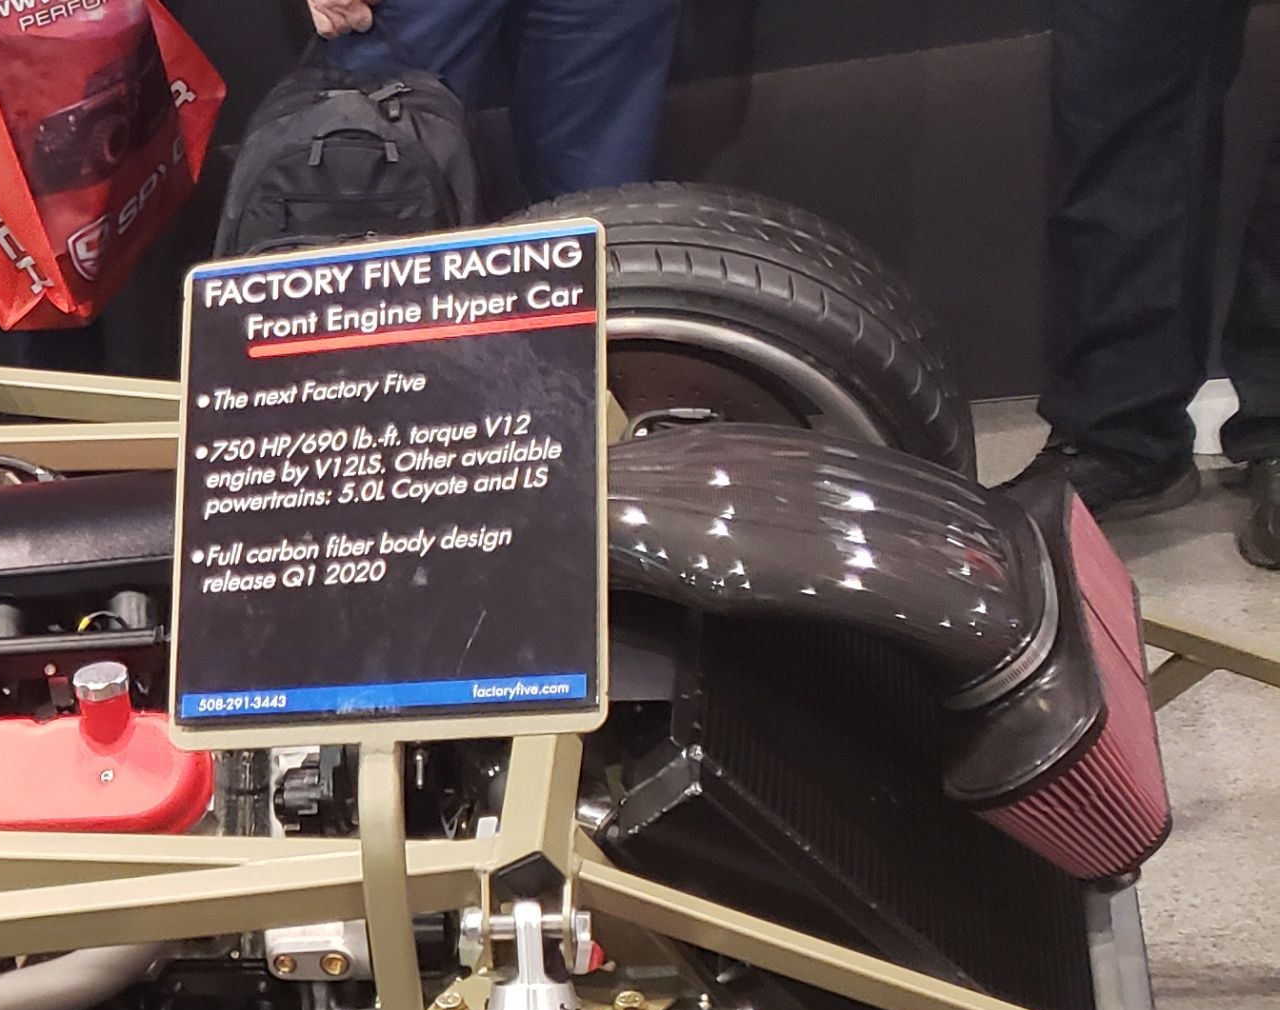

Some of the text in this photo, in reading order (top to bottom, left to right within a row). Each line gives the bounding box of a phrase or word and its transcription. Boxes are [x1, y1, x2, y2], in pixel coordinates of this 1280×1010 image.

[19, 0, 108, 32] PERFO
[205, 240, 583, 308] FACTORY FIVE RACING
[247, 281, 583, 340] Front Engine Hyper Car
[213, 373, 427, 411] The next Factory Five
[209, 412, 532, 463] 750 HP/690 lb.-ft. torque V12
[205, 436, 563, 492] engine by V12LS. Other available
[204, 464, 550, 521] powertrains: 5.0L Coyote and LS
[205, 524, 513, 567] Full carbon fiber body design
[202, 560, 387, 594] release Q1 2020
[197, 681, 570, 713] 508-291-3443 factoryfive.com
